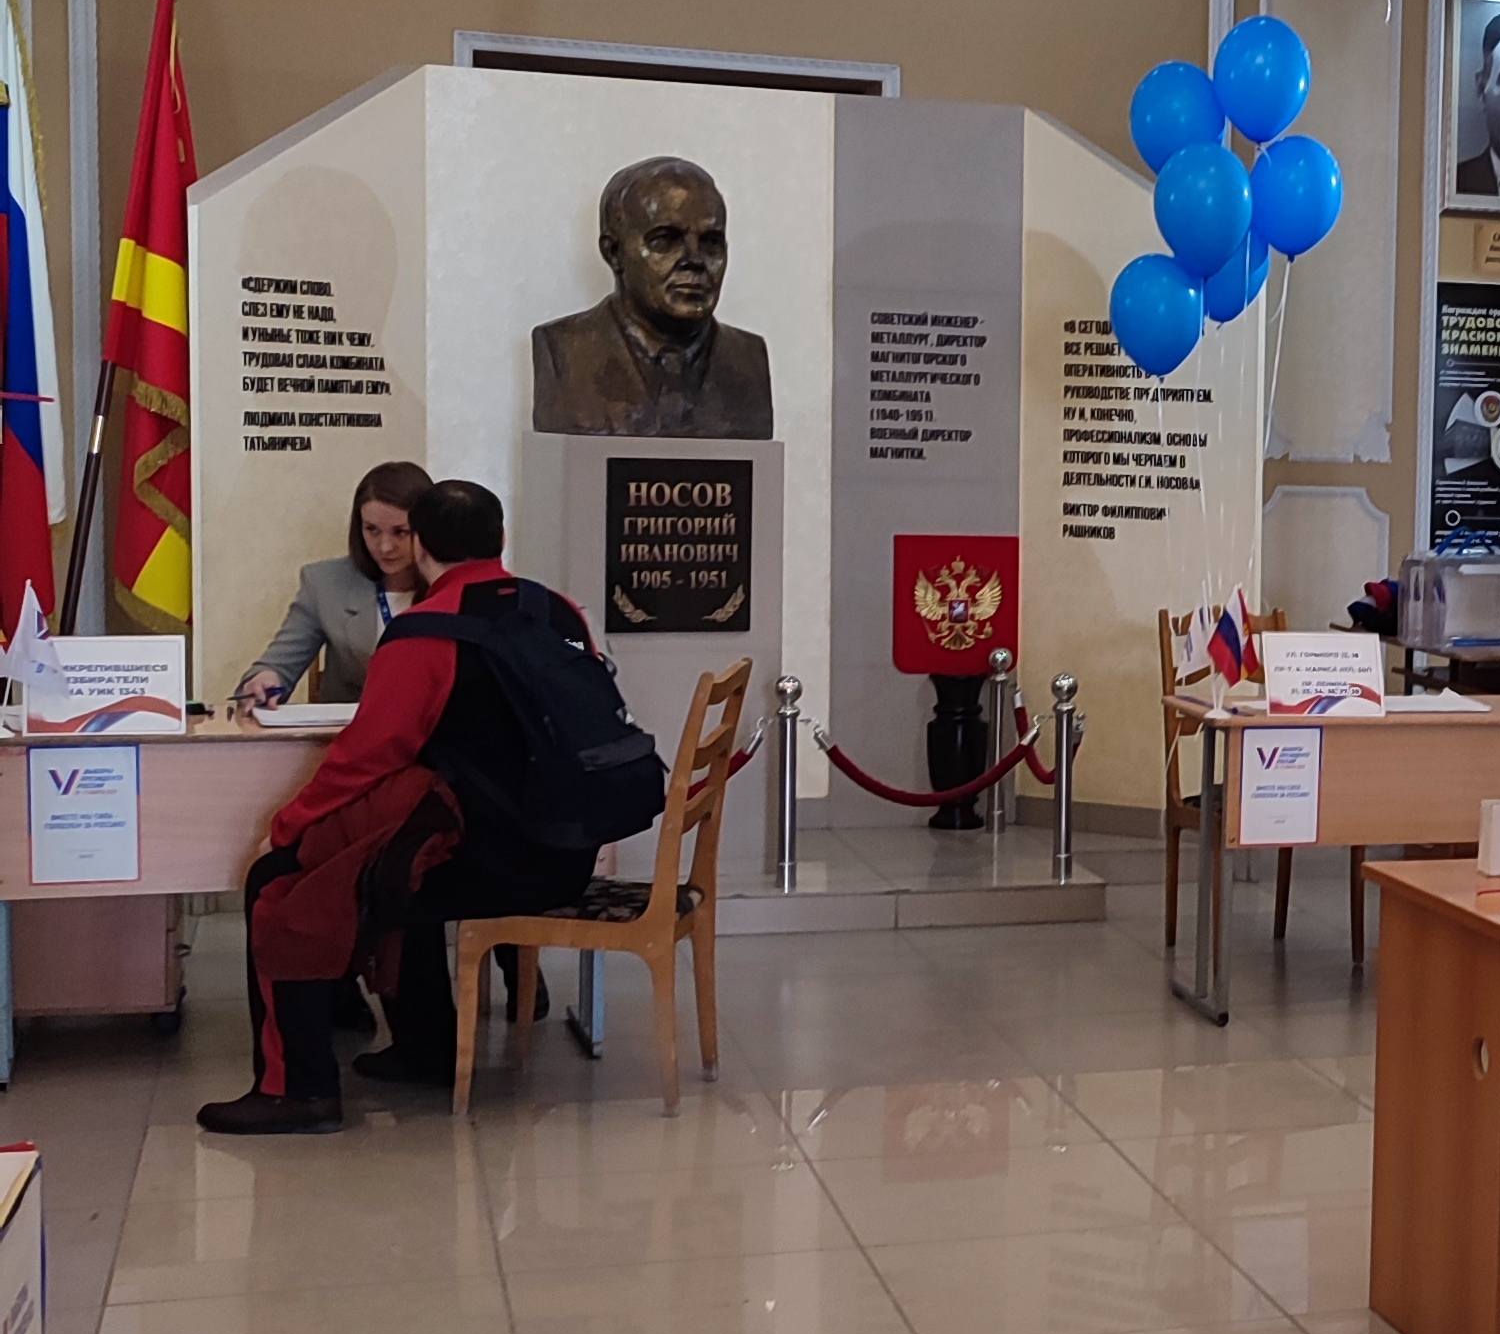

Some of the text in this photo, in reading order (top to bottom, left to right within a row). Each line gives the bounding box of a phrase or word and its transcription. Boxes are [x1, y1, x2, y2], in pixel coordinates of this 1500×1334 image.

[242, 301, 267, 317] СЛЕЗ
[270, 303, 291, 319] ЕМУ
[293, 304, 305, 320] НЕ
[870, 312, 928, 326] СОВЕТСКИЙ
[242, 326, 249, 341] И
[295, 329, 321, 345] ТОЖЕ
[936, 334, 987, 348] ДИРЕКТОР
[1064, 342, 1121, 356] ВСЕ РЕШАЕТ
[242, 351, 385, 371] ТРУДОВАЯ СЛАВА КОМБИНАТА
[870, 351, 967, 366] МАГНИТОГОРСКОГО
[870, 370, 980, 386] МЕТАЛЛУРГИЧЕСКОГО
[1064, 363, 1142, 379] ОПЕРАТИВНОСТЬ
[243, 376, 275, 393] БУДЕТ
[278, 375, 315, 393] ВЕЧНОЙ
[318, 379, 363, 394] ПАМЯТЬЮ
[870, 389, 931, 403] КОМБИНАТА
[1064, 385, 1131, 401] РУКОВОДСТВЕ
[243, 411, 382, 428] ЛЮДМИЛА КОНСТАНТИНОВНА
[1064, 407, 1075, 420] НУ
[1090, 408, 1137, 424] КОНЕЧНО,
[870, 426, 972, 442] ВОЕННЫЙ ДИРЕКТОР
[243, 436, 312, 451] ТАТЬЯНИЧЕВА
[1063, 450, 1110, 465] КОТОРОГО
[1113, 452, 1129, 466] МЫ
[1132, 453, 1177, 468] ЧЕРПАЕМ
[1062, 471, 1136, 487] ДЕЯТЕЛЬНОСТИ
[628, 482, 732, 507] НОСОВ
[1063, 502, 1099, 518] ВИКТОР
[623, 512, 736, 535] ГРИГОРИЙ
[1063, 524, 1116, 540] РАШНИКОВ
[620, 544, 739, 562] ИВАНОВИЧ
[632, 570, 672, 589] 1905
[689, 570, 728, 589] 1951
[88, 688, 115, 696] УИК
[119, 687, 146, 695] 1343
